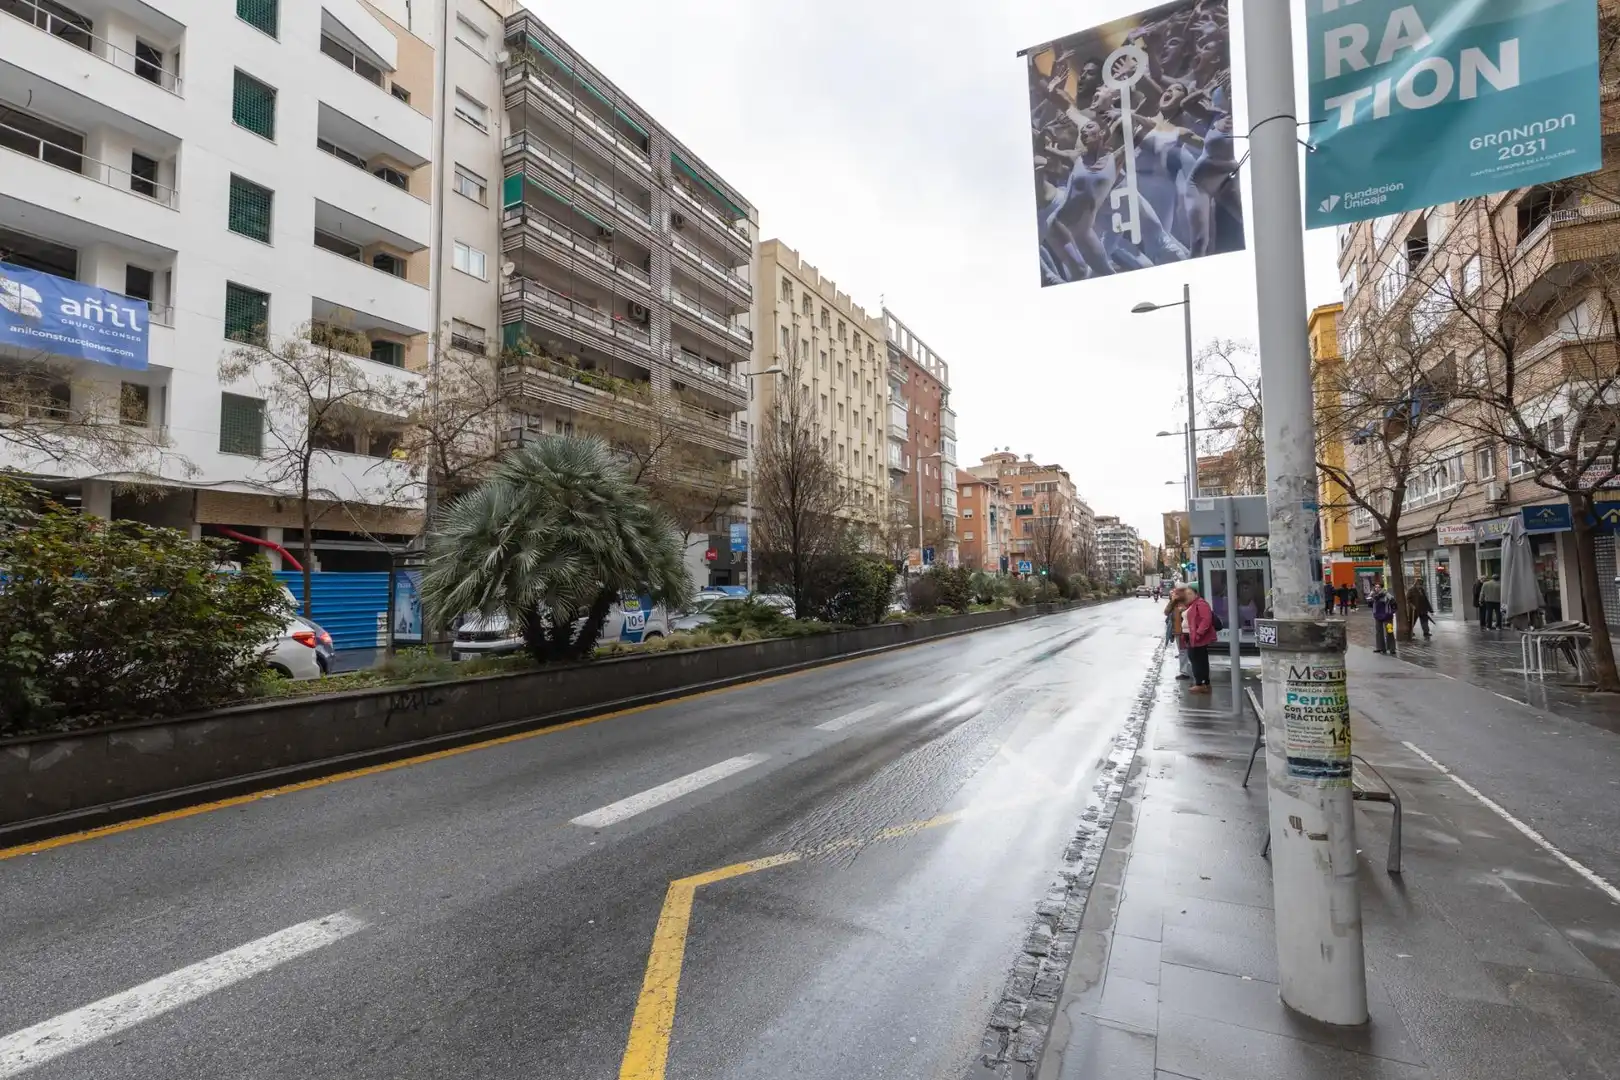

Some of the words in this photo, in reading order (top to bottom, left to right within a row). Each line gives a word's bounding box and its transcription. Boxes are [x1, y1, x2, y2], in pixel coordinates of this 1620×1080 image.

[1324, 4, 1434, 79] RA
[1324, 38, 1520, 130] TION
[1469, 113, 1576, 150] GRANADA
[1498, 138, 1546, 161] 2031
[1344, 182, 1404, 201] Fundación
[1343, 193, 1387, 211] Unicaja
[60, 296, 142, 334] añil
[60, 318, 95, 331] GRUPO
[1209, 558, 1264, 569] VALNTINO
[1259, 626, 1276, 636] SON
[1259, 634, 1276, 644] RYZ
[1284, 704, 1301, 713] Con
[1303, 706, 1313, 714] 12
